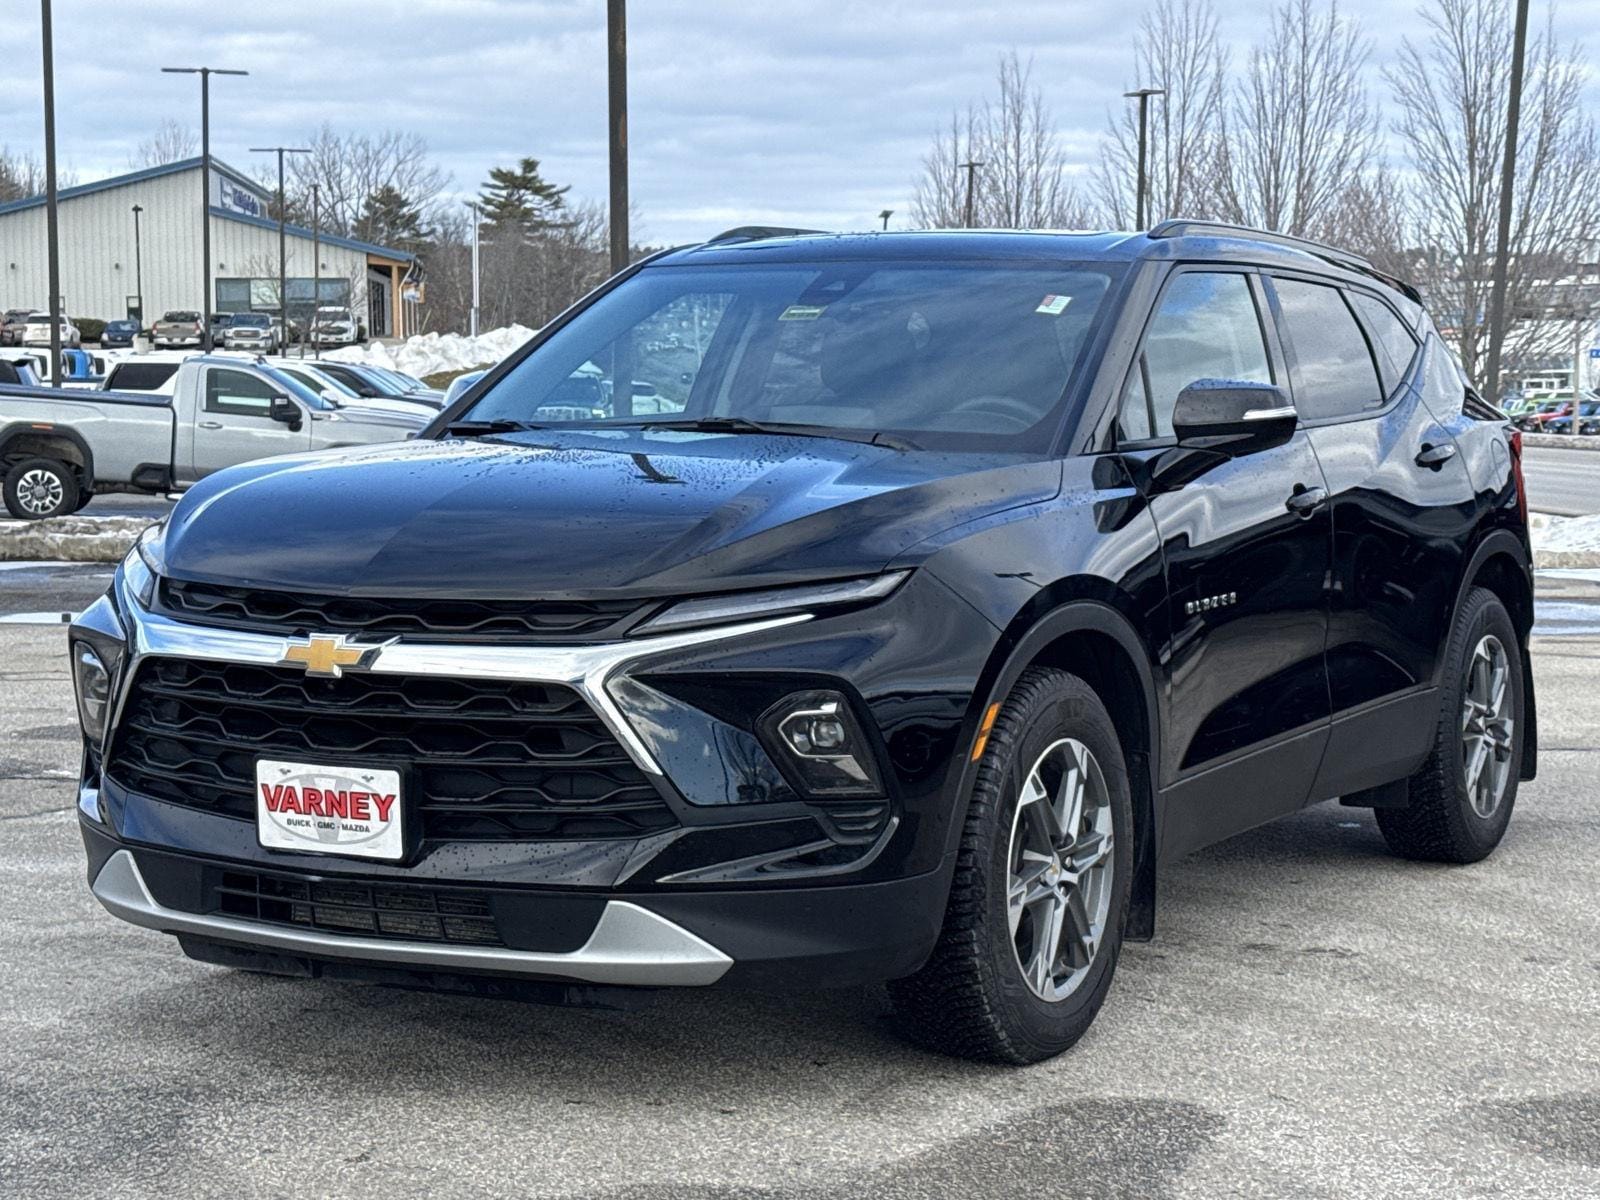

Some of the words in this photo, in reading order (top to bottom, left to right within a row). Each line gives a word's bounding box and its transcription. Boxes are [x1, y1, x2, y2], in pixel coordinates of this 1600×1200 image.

[260, 783, 397, 823] VARNEY
[286, 818, 311, 828] BUICK
[317, 821, 335, 830] GMC
[341, 823, 371, 833] MAZDA
